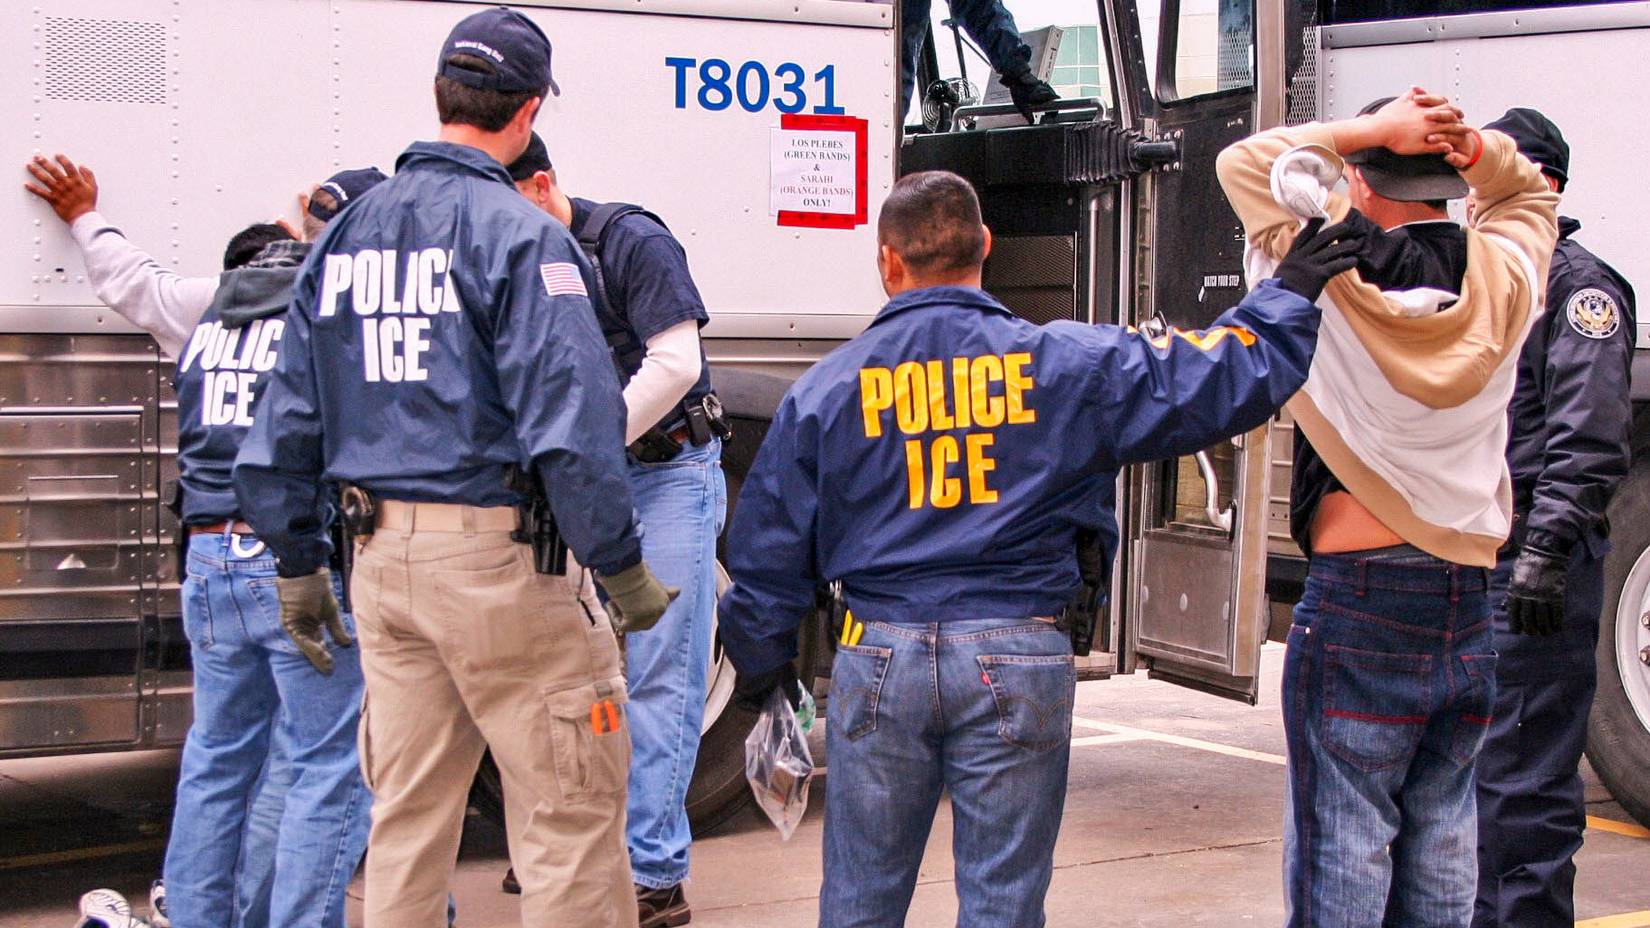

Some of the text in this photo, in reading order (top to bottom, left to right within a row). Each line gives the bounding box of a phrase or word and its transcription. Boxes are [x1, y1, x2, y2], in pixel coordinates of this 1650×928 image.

[665, 57, 845, 115] T8031
[784, 151, 851, 161] (GREEN BANDS)
[792, 139, 843, 149] LOS PLEBES
[813, 163, 821, 172] &
[780, 186, 854, 198] (ORANGE BANDS)
[803, 198, 831, 207] ONLY!
[1229, 275, 1240, 287] STEP
[180, 318, 286, 373] POLIC
[363, 316, 432, 383] ICE
[201, 371, 258, 427] ICE
[859, 352, 1036, 438] POLICE
[905, 432, 998, 510] ICE
